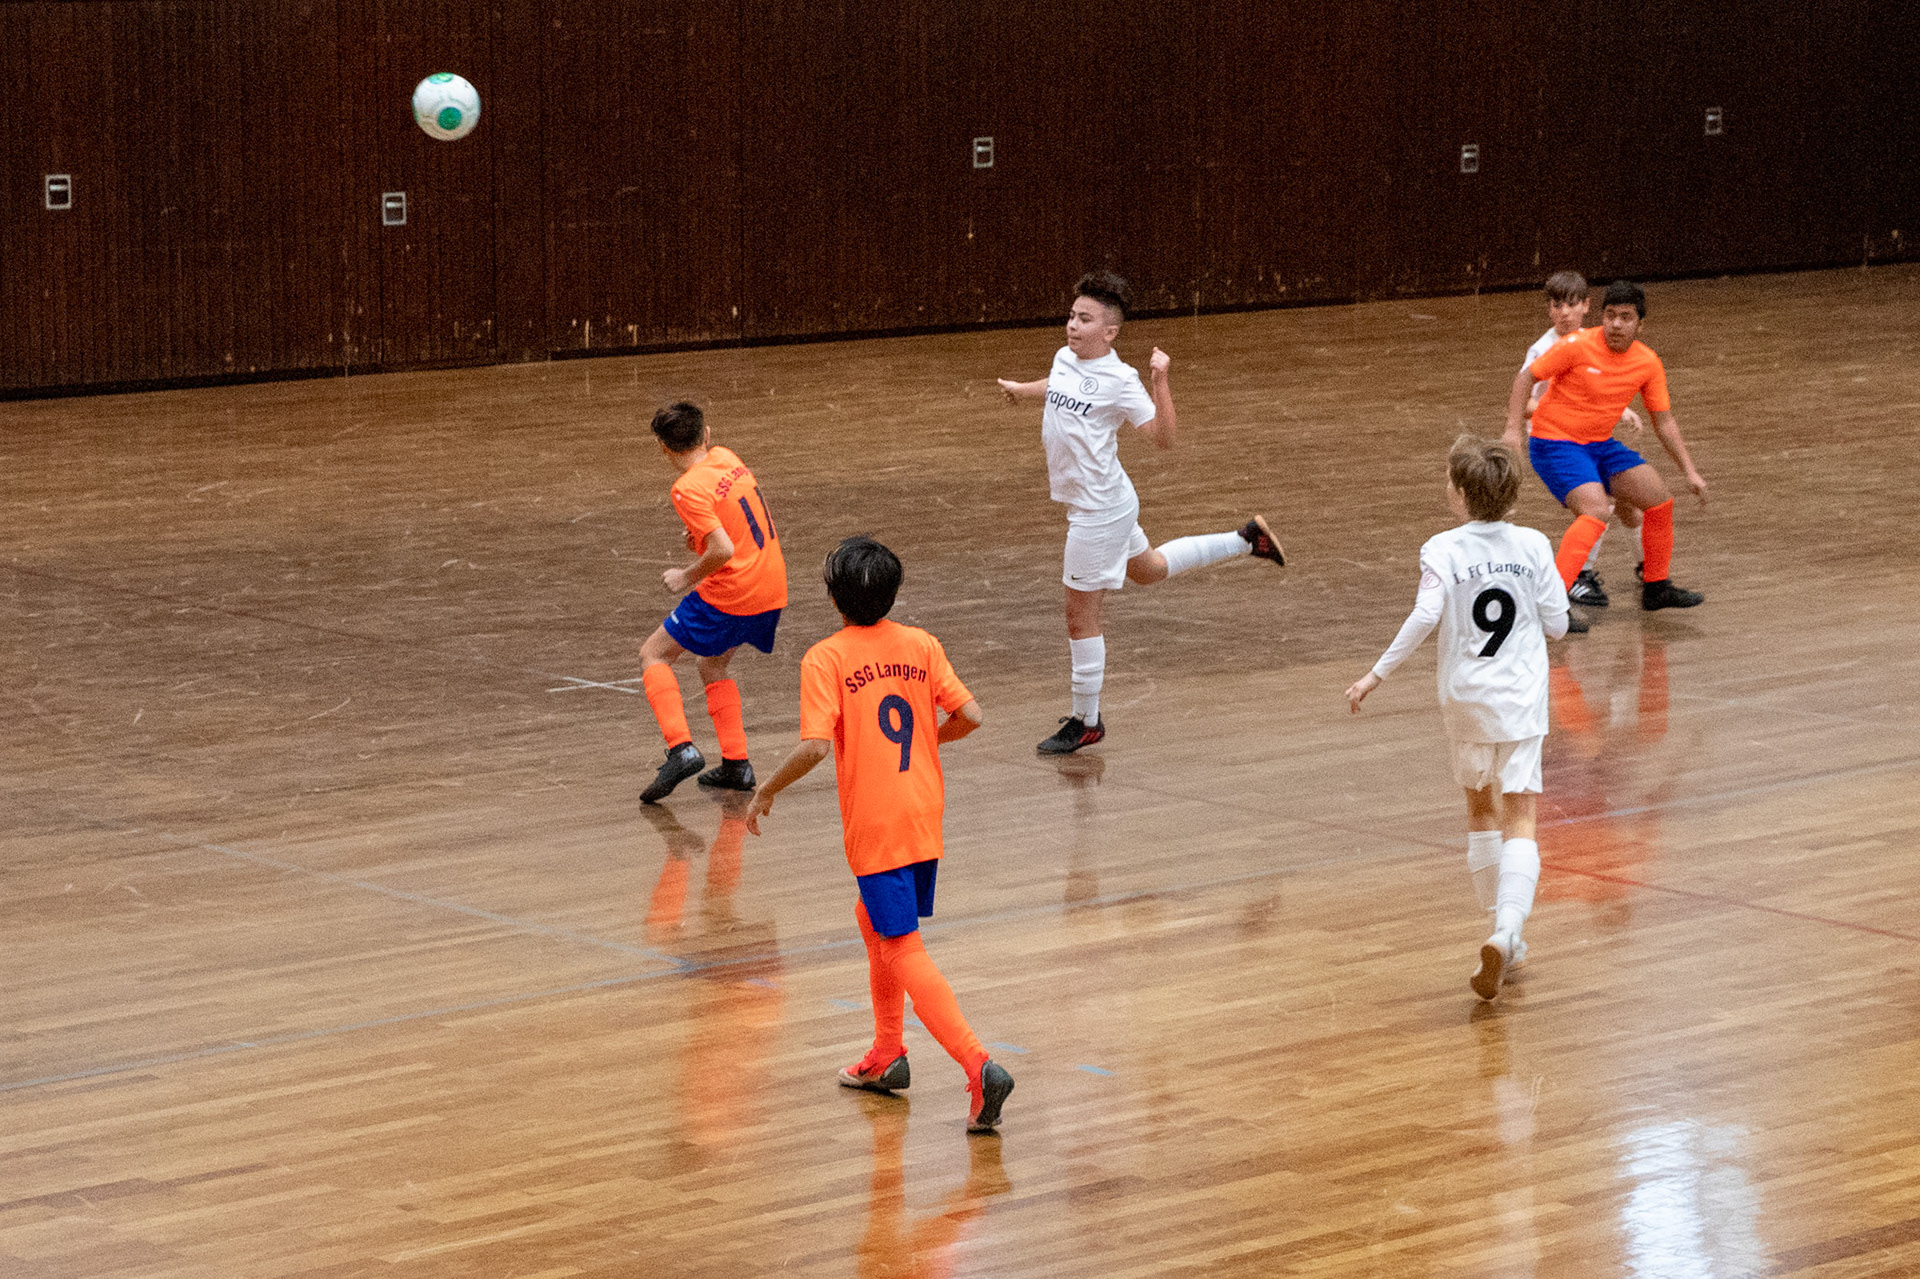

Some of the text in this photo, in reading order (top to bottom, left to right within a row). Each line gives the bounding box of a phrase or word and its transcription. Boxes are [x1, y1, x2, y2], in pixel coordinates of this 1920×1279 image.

[1047, 384, 1093, 417] raport
[715, 476, 732, 498] SSG
[738, 485, 775, 550] 11
[1468, 563, 1483, 579] FC
[1487, 561, 1534, 579] Langen
[1472, 587, 1517, 658] 9
[845, 662, 927, 694] SSG Langen
[878, 694, 914, 773] 9
